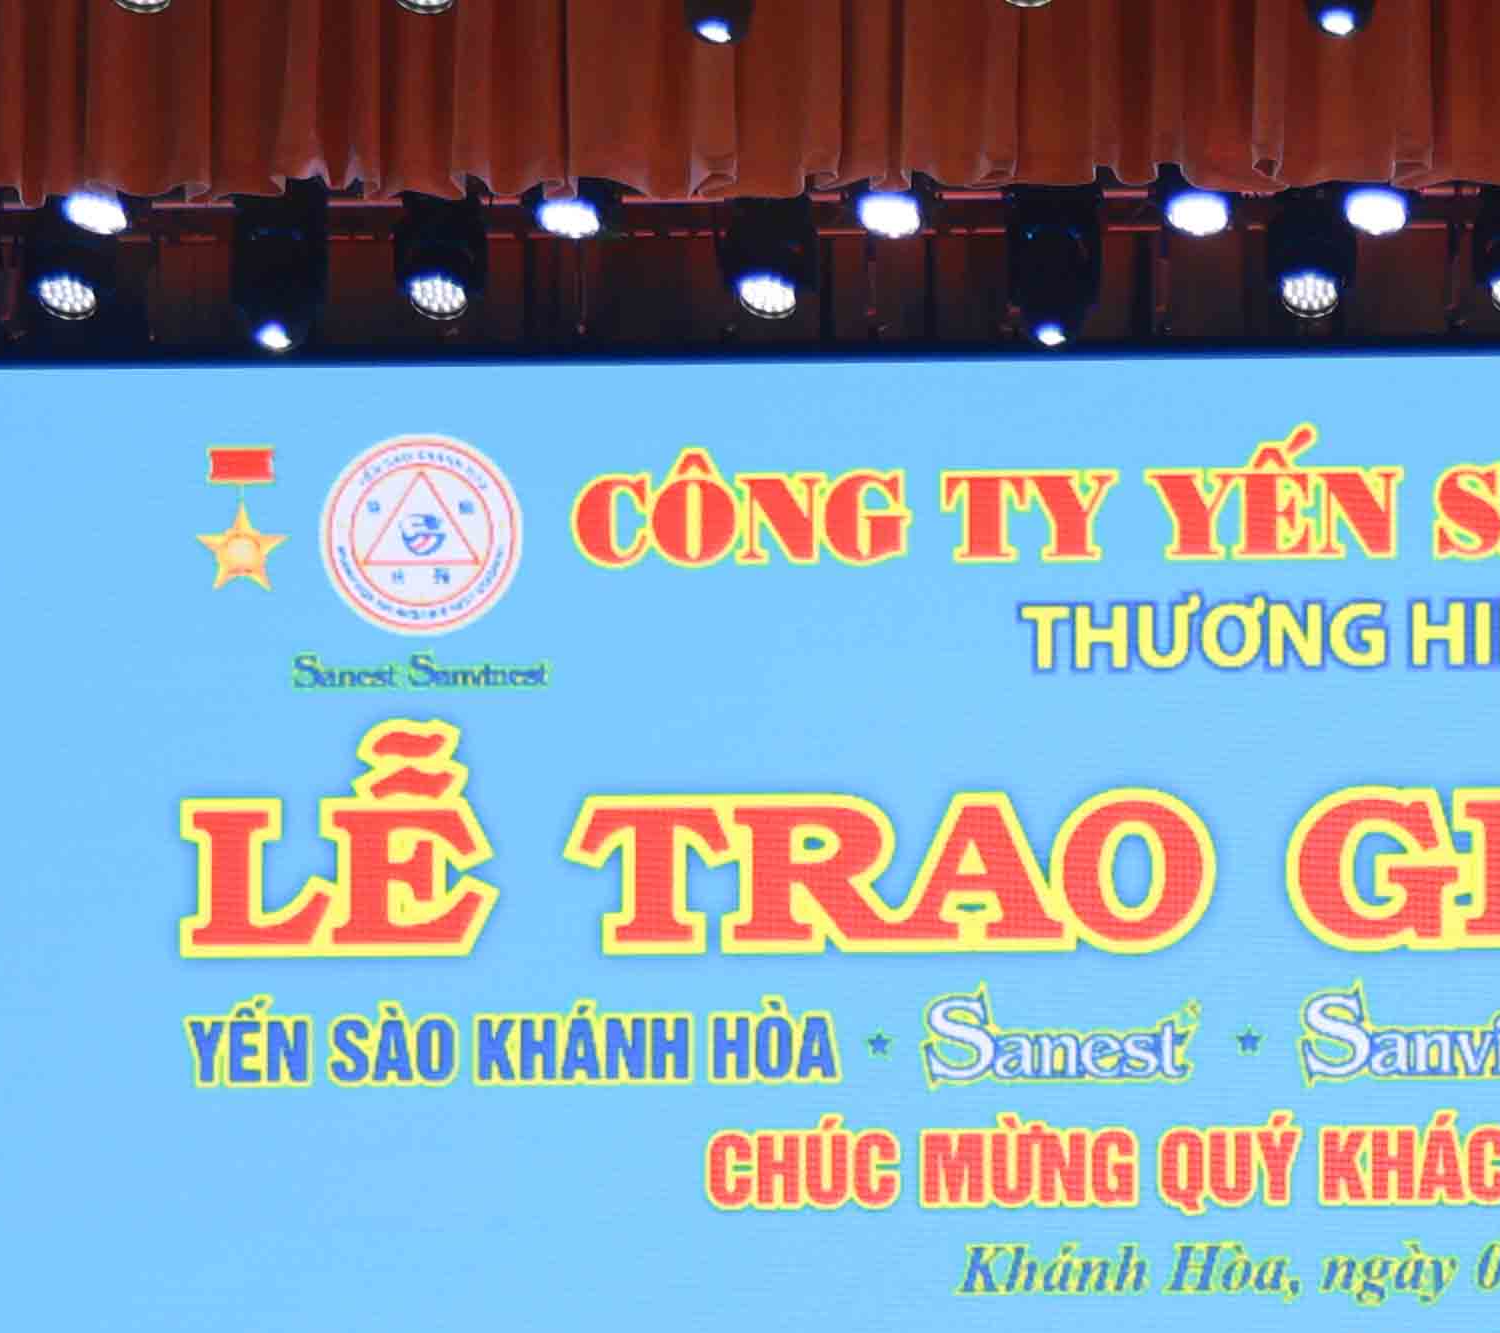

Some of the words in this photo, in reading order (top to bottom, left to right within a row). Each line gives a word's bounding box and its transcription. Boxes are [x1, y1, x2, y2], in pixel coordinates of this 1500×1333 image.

[569, 444, 914, 570] CÔNG
[938, 467, 1120, 565] TY
[1144, 422, 1406, 562] YẾN
[1018, 592, 1388, 671] THƯƠNG
[177, 717, 500, 960] LỄ
[563, 786, 1217, 957] TRAO
[183, 993, 315, 1089] YẾN
[327, 999, 459, 1088] SÀO
[471, 997, 694, 1087] KHÁNH
[707, 995, 841, 1085] HÒA
[920, 980, 1194, 1089] Sanest
[704, 1113, 900, 1212] CHÚC
[917, 1112, 1141, 1211] MỪNG
[1156, 1110, 1304, 1216] QUÝ
[956, 1241, 1149, 1296] Khánh
[1163, 1240, 1300, 1302] Hòa,
[1319, 1239, 1459, 1308] ngày
